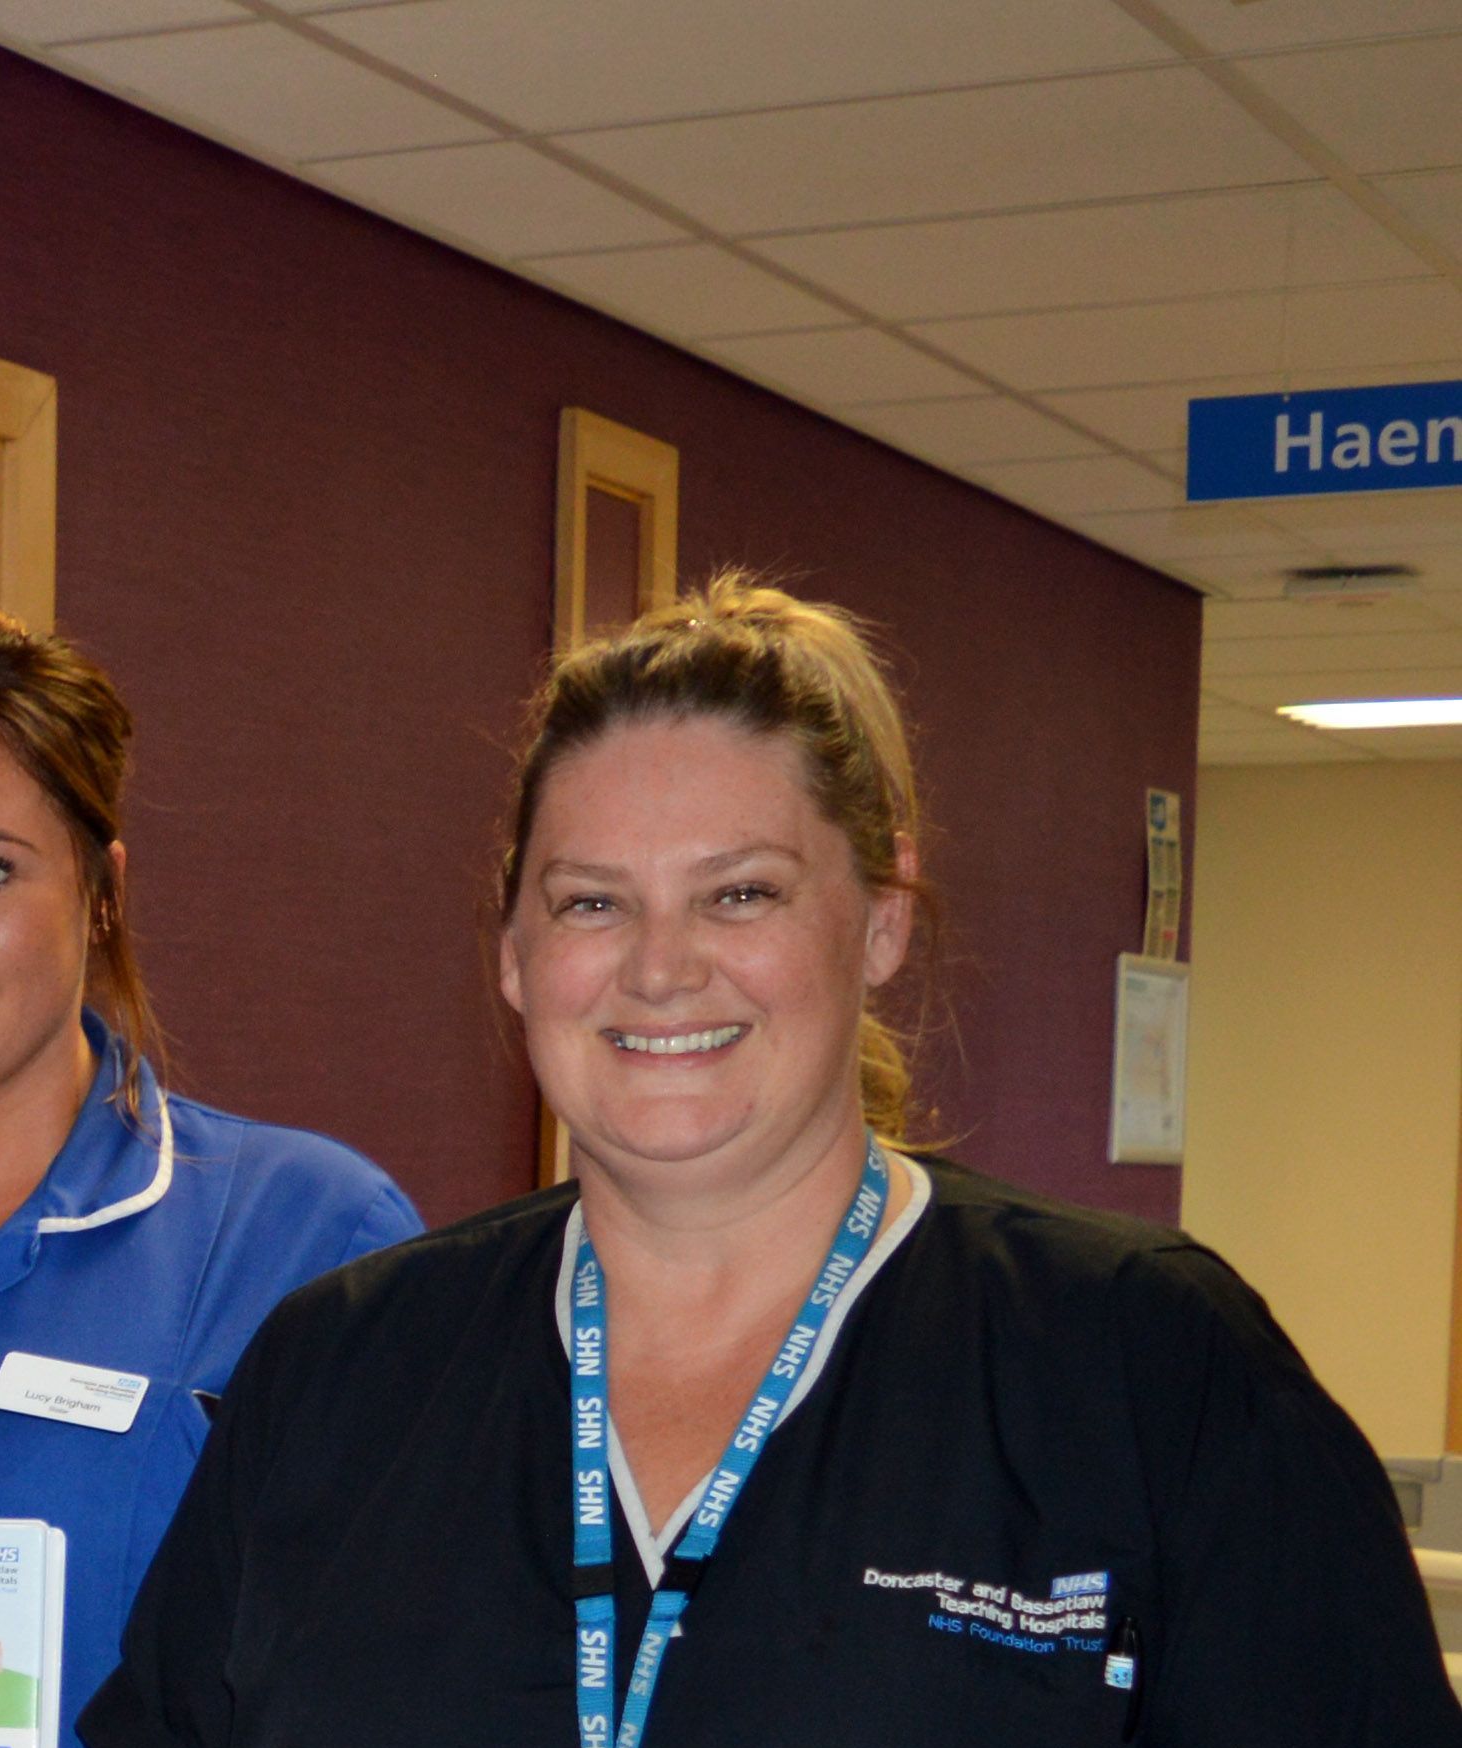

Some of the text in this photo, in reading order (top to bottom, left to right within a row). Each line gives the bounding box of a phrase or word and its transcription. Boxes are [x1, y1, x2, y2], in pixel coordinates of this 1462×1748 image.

[846, 1185, 881, 1239] NHS
[577, 1261, 597, 1306] NHS
[812, 1253, 854, 1307] NHS
[577, 1326, 600, 1375] NHS
[773, 1325, 816, 1379] NHS
[25, 1390, 51, 1404] Lucy
[55, 1396, 101, 1412] Brigham
[578, 1397, 601, 1449] NHS
[734, 1397, 779, 1452] NHS
[578, 1470, 603, 1525] NHS
[698, 1471, 739, 1527] NHS
[864, 1568, 1105, 1616] Doncaster and Bassetlaw
[1056, 1574, 1105, 1593] NHS
[928, 1614, 1104, 1653] NHS Foundation Trust
[936, 1592, 1105, 1634] Teaching Hospitals
[580, 1630, 606, 1688] NHS
[632, 1633, 661, 1696] NHS
